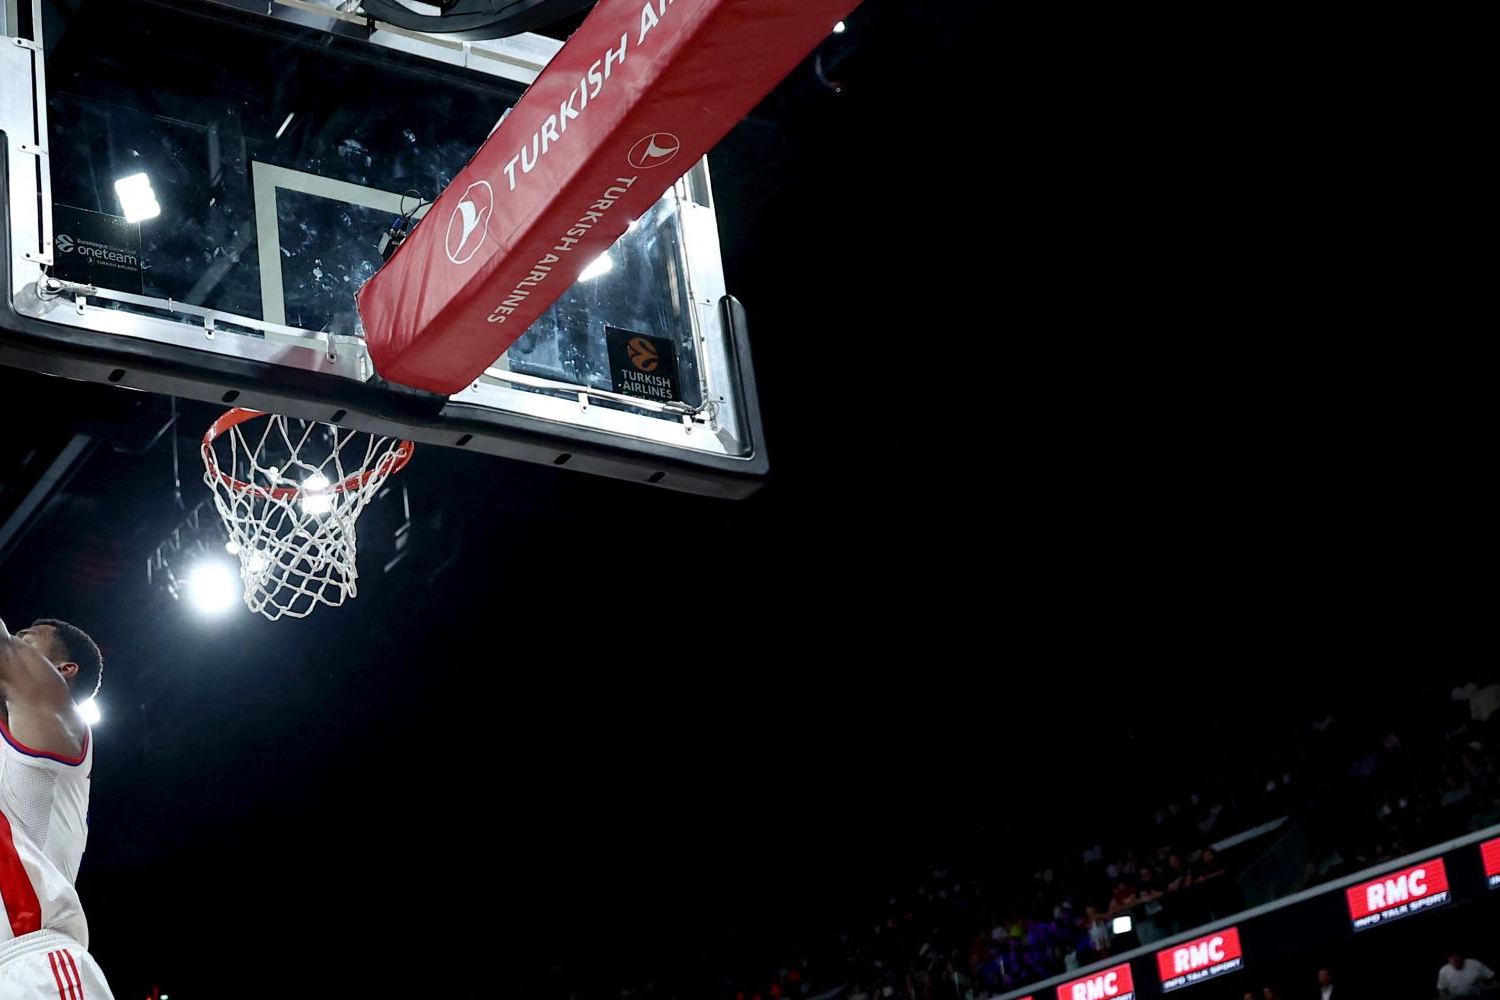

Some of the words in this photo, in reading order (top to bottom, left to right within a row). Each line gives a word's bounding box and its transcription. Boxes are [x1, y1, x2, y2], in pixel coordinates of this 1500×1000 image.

[503, 32, 628, 191] TURKISH
[561, 175, 638, 254] TURKISH
[77, 245, 137, 266] oneteam
[487, 252, 560, 325] AIRLINES
[621, 369, 671, 388] TURKISH
[622, 380, 673, 399] AIRLINES
[1366, 868, 1428, 912] RMC
[1173, 936, 1226, 974] RMC
